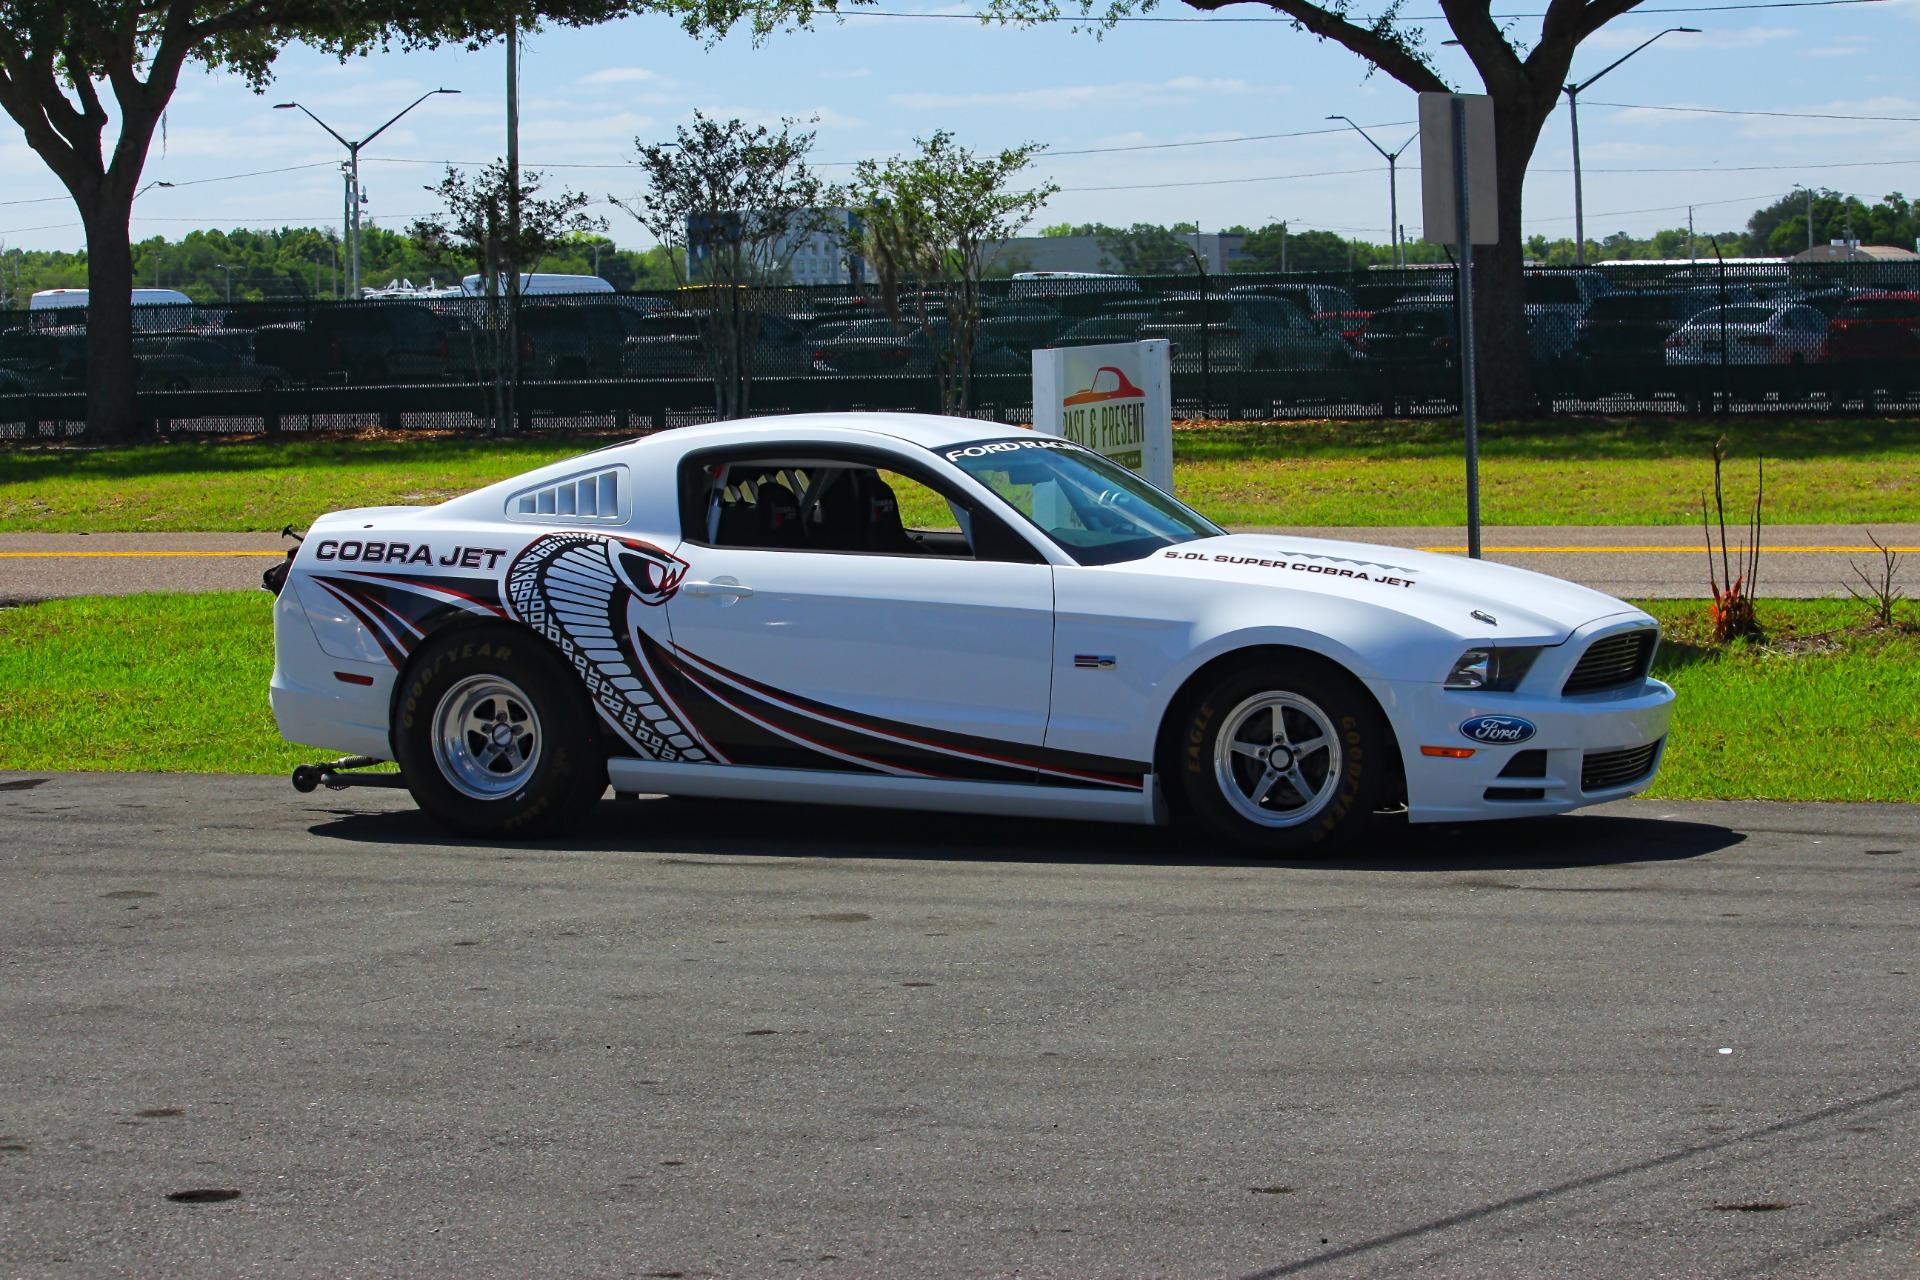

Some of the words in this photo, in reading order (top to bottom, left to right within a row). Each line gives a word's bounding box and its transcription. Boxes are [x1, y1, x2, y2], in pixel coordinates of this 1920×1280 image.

[1090, 408, 1096, 449] &
[1102, 403, 1144, 447] PRESENT
[945, 442, 1020, 462] FORD
[1018, 441, 1082, 452] RAC
[316, 540, 433, 566] COBRA
[440, 545, 507, 570] JET
[1164, 551, 1209, 562] 5.0L
[1214, 555, 1287, 569] SUPER
[1291, 562, 1369, 580] COBRA
[1374, 575, 1416, 588] JET
[403, 641, 512, 729] GOODYEAR
[1475, 718, 1522, 739] Ford
